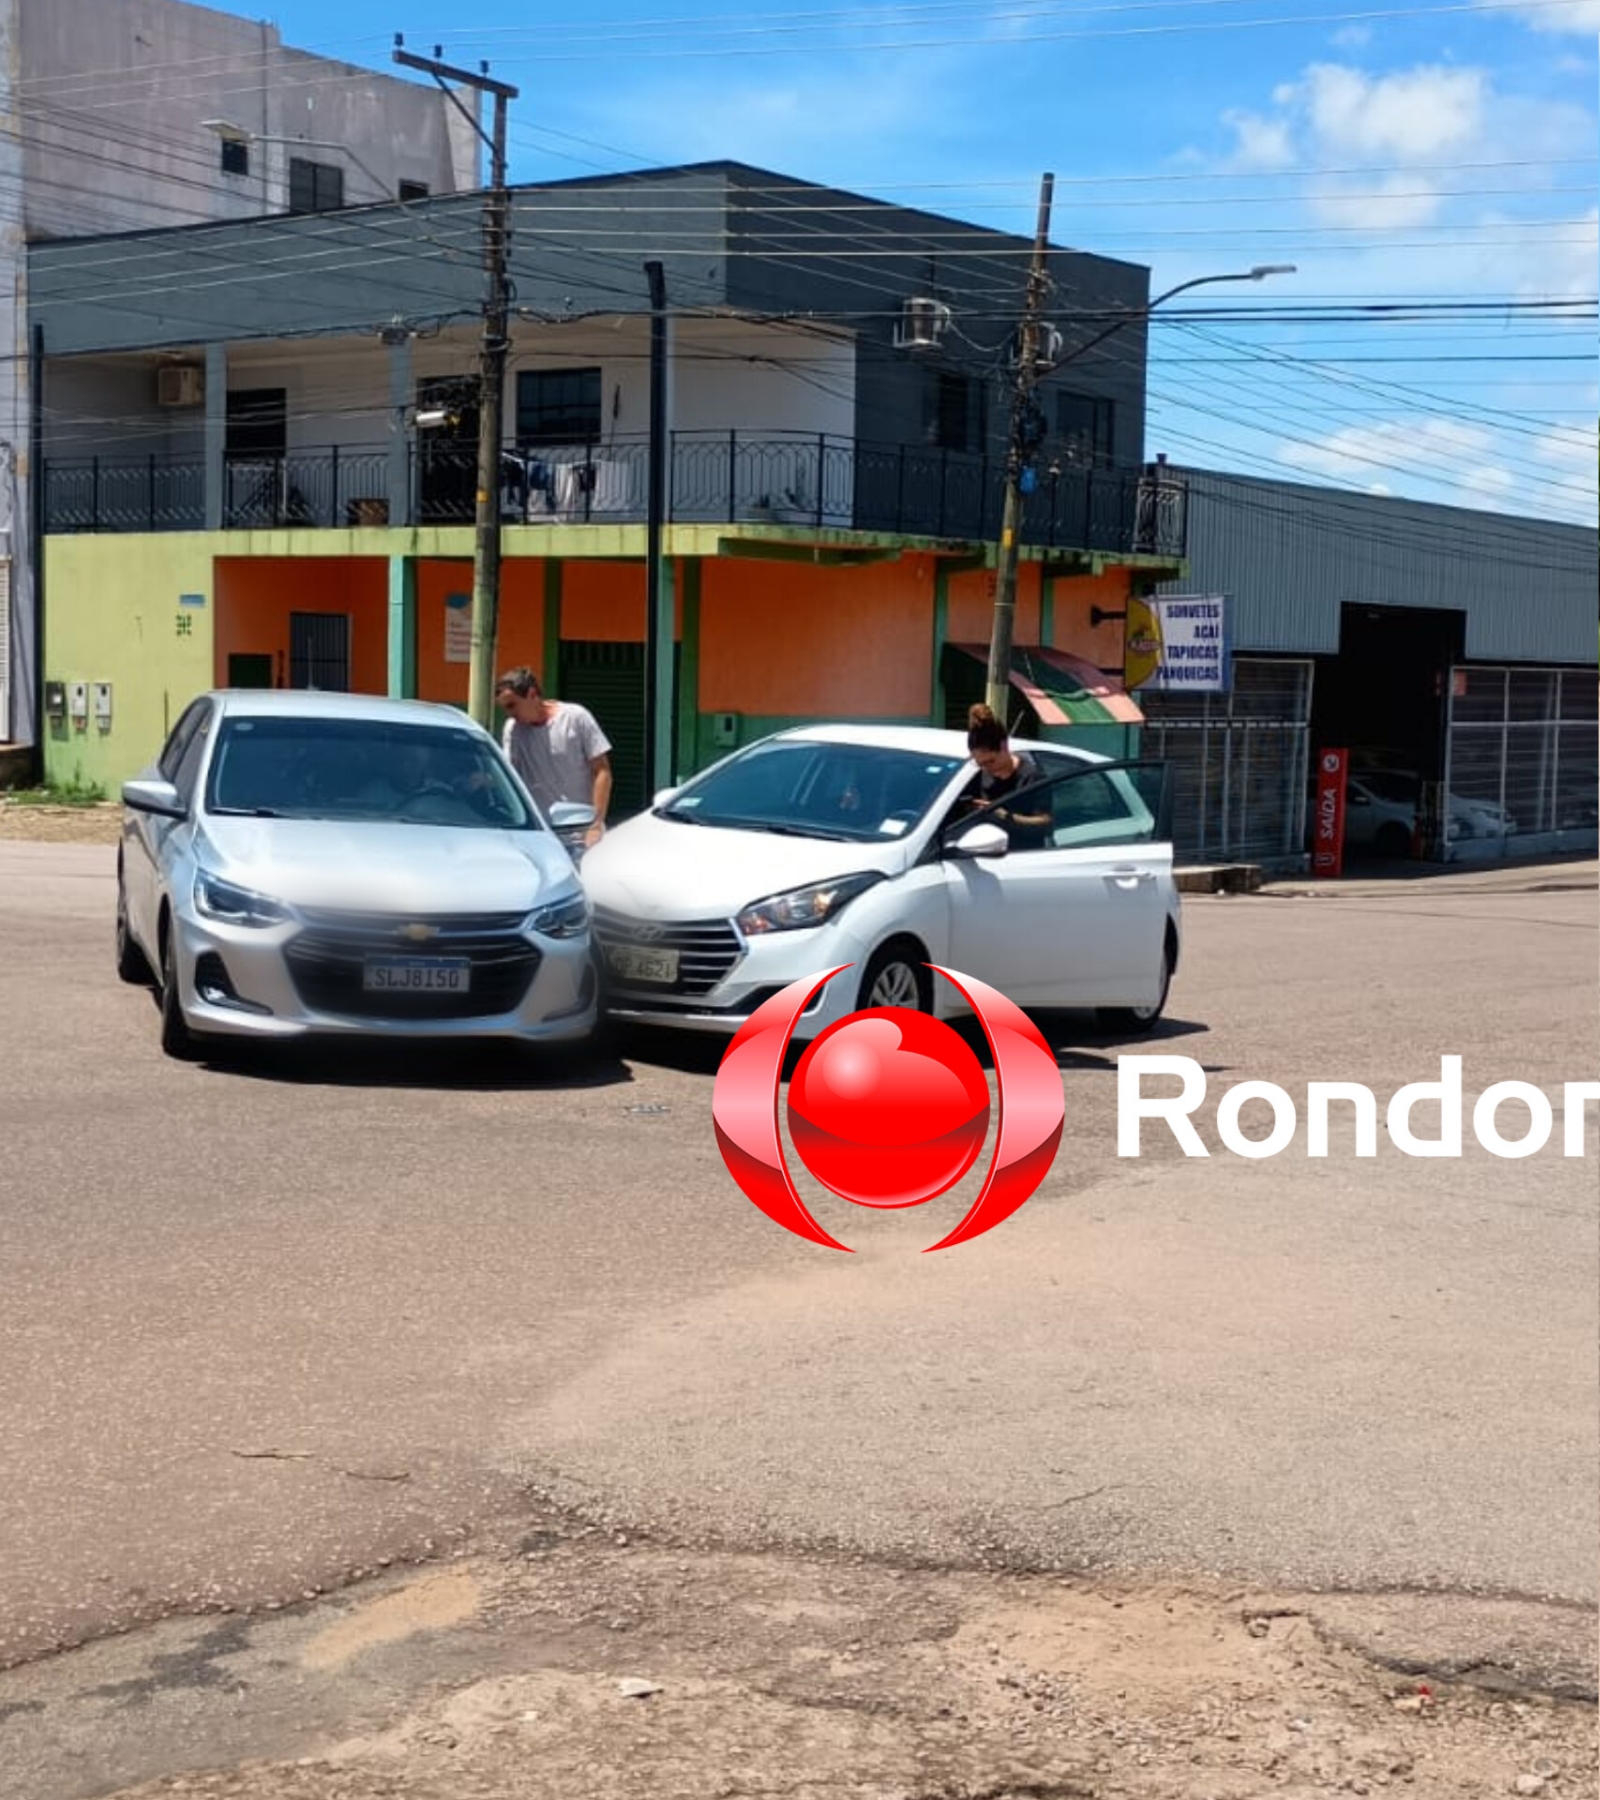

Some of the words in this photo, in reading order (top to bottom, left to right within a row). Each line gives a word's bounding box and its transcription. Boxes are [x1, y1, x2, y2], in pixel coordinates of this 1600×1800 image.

[1166, 604, 1220, 618] SORVETES
[1167, 645, 1219, 660] TAPIOCAS
[1156, 666, 1219, 682] PANQUECAS
